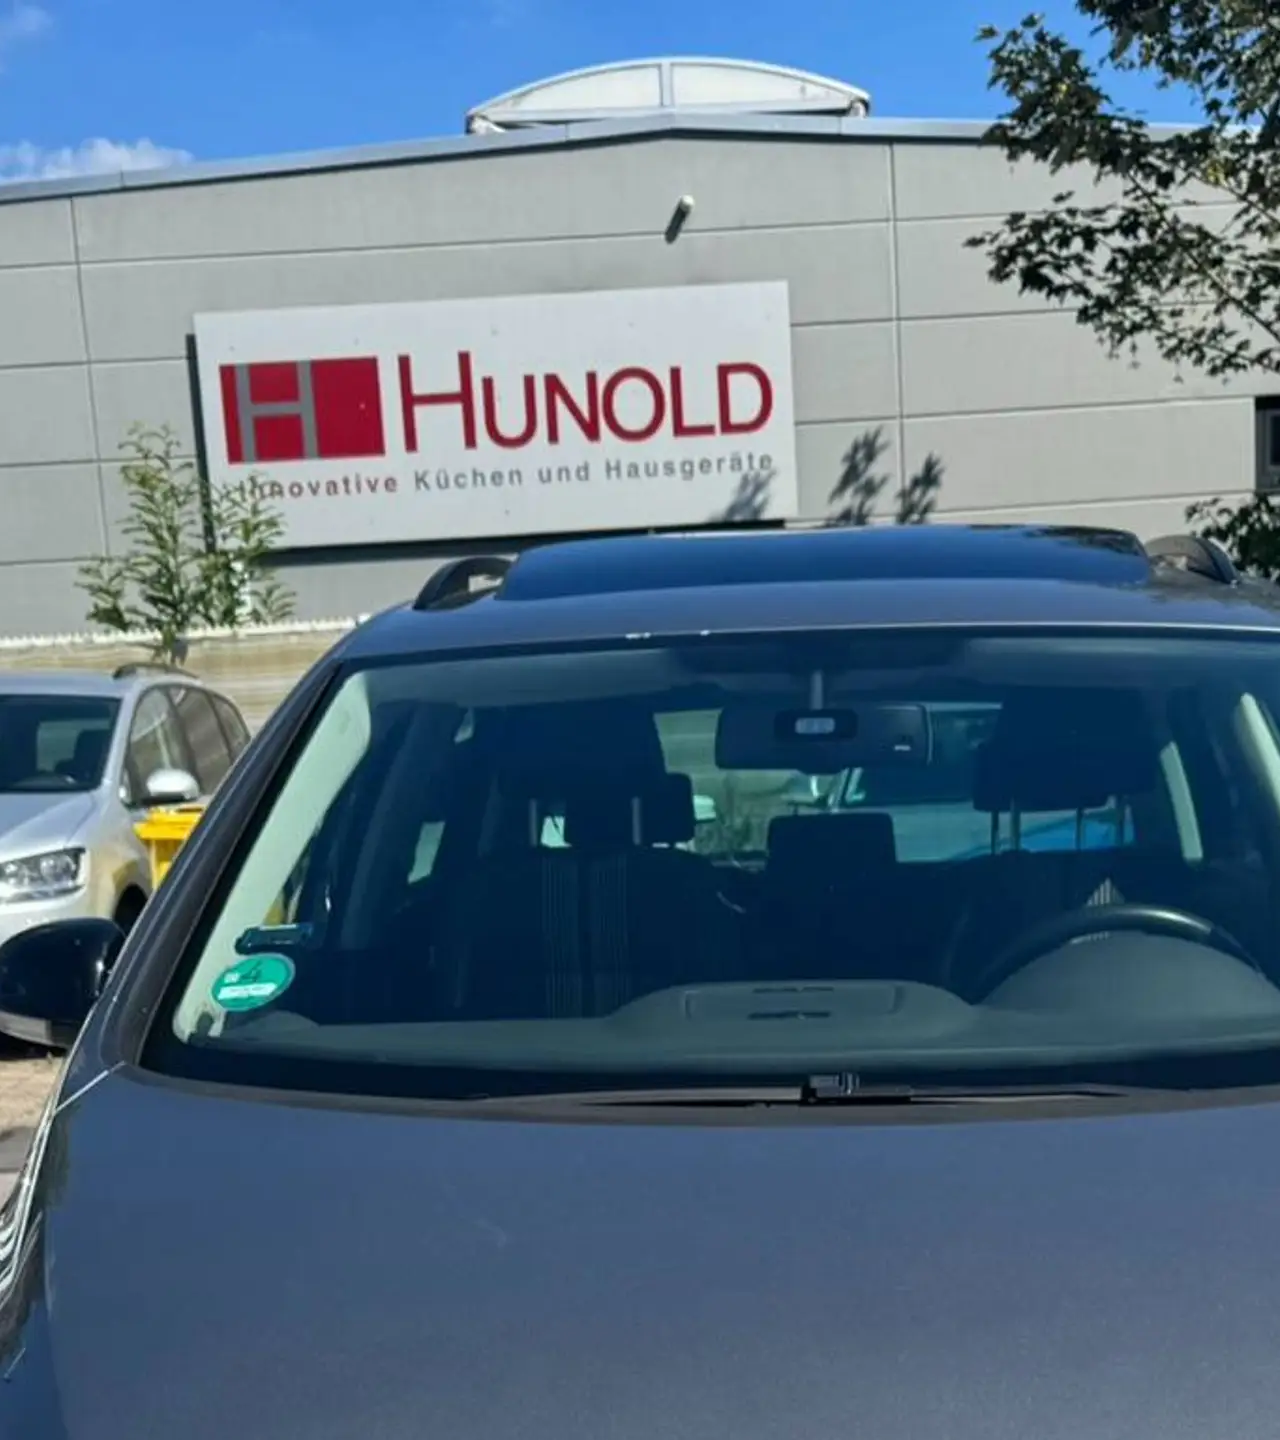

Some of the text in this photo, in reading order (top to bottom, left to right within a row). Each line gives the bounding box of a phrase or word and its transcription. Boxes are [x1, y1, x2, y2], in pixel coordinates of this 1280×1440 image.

[414, 466, 523, 492] Küchen
[538, 461, 590, 484] und
[605, 452, 774, 481] Hausgeräte
